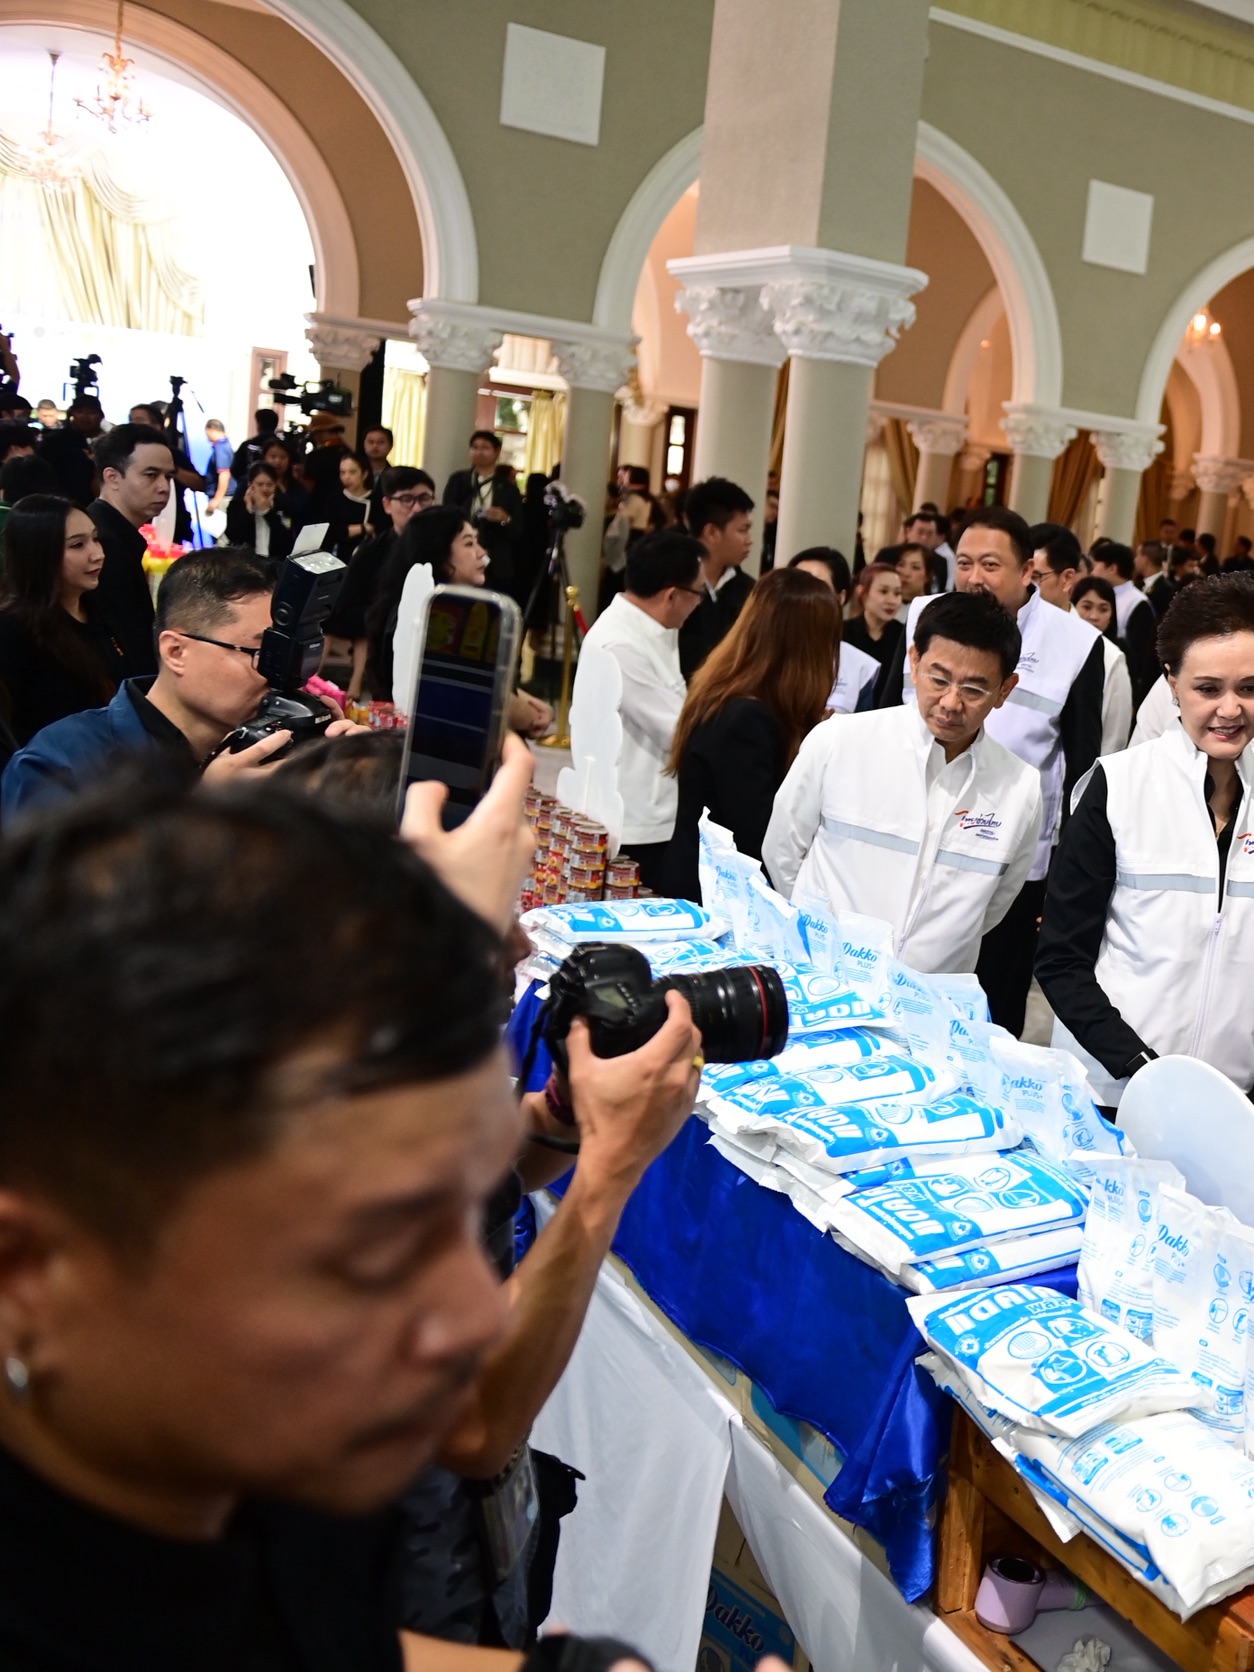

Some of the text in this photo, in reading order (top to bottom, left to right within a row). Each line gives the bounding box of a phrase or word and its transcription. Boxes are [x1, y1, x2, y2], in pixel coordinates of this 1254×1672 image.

[802, 913, 829, 935] Dakko
[842, 941, 878, 963] Dakko
[1158, 1223, 1190, 1258] Dakko
